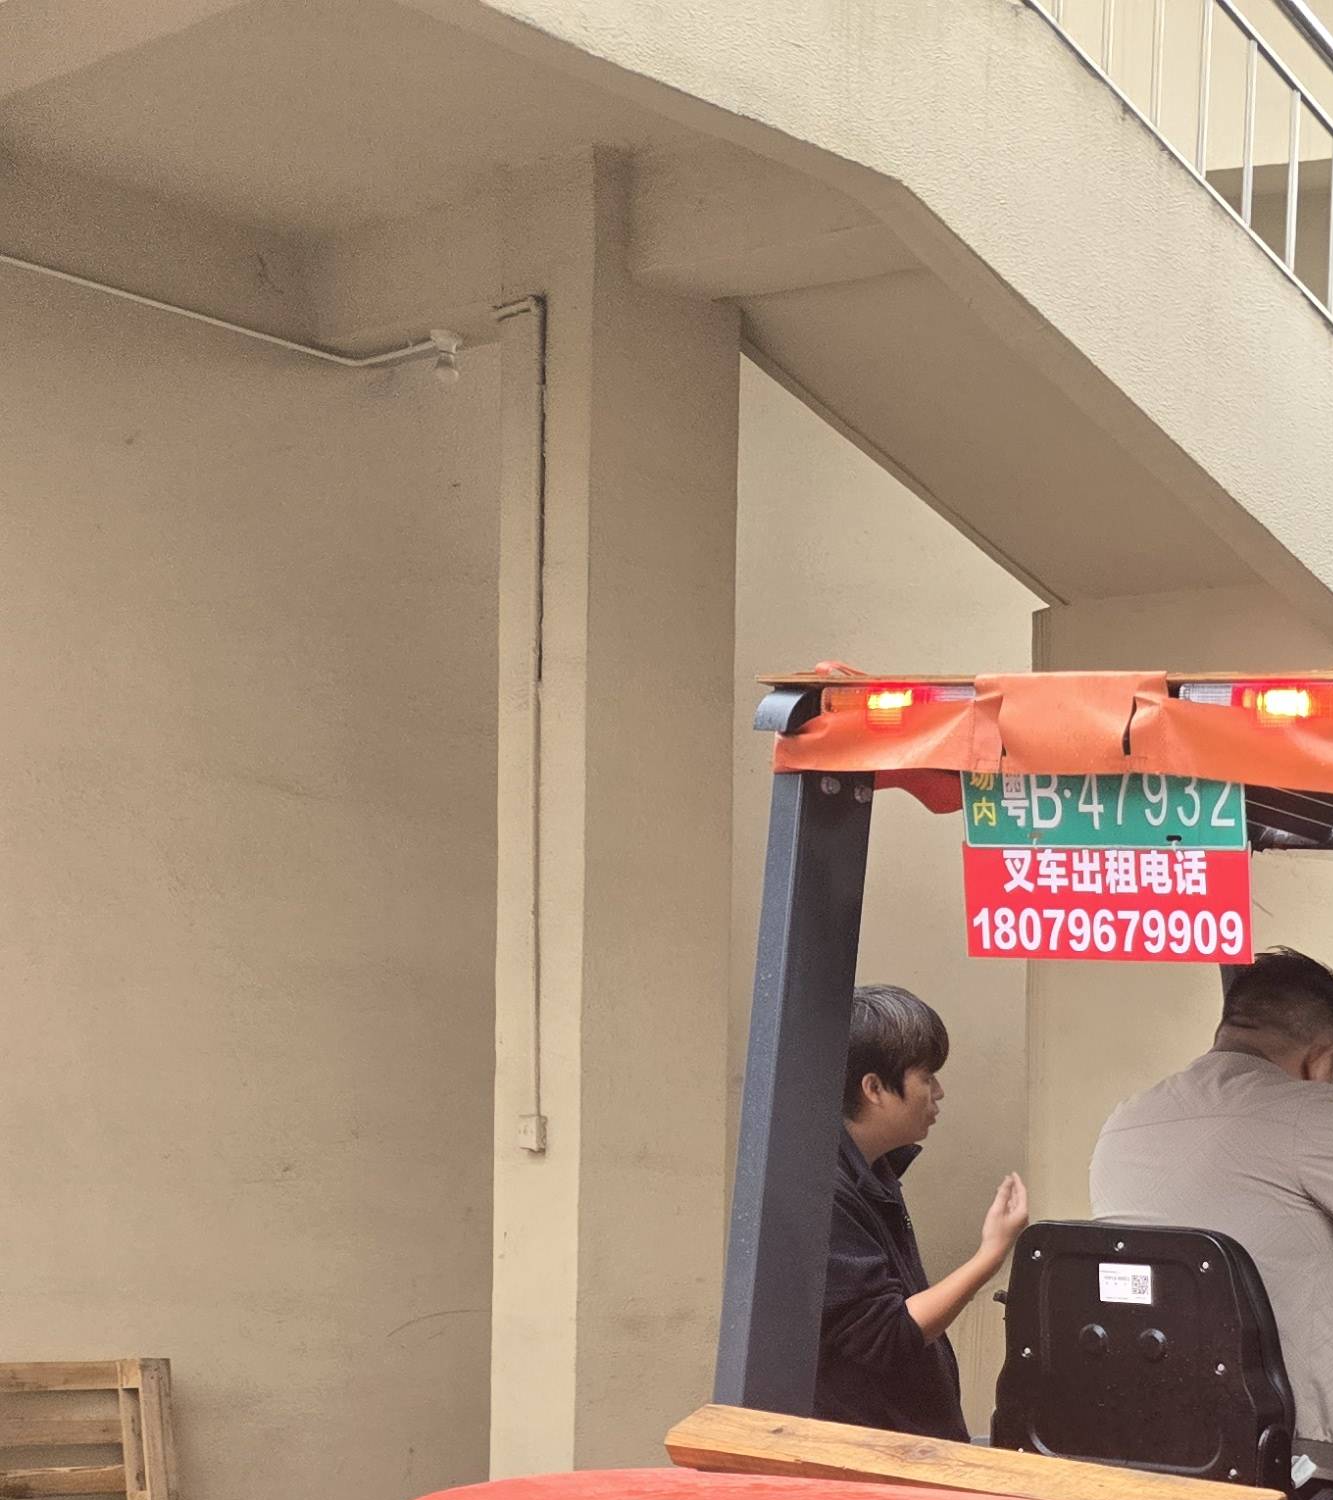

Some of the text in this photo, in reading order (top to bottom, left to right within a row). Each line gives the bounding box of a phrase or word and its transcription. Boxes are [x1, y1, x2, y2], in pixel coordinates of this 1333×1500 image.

[1002, 848, 1208, 896] 叉车出租电话
[972, 906, 1244, 956] 18079679909
